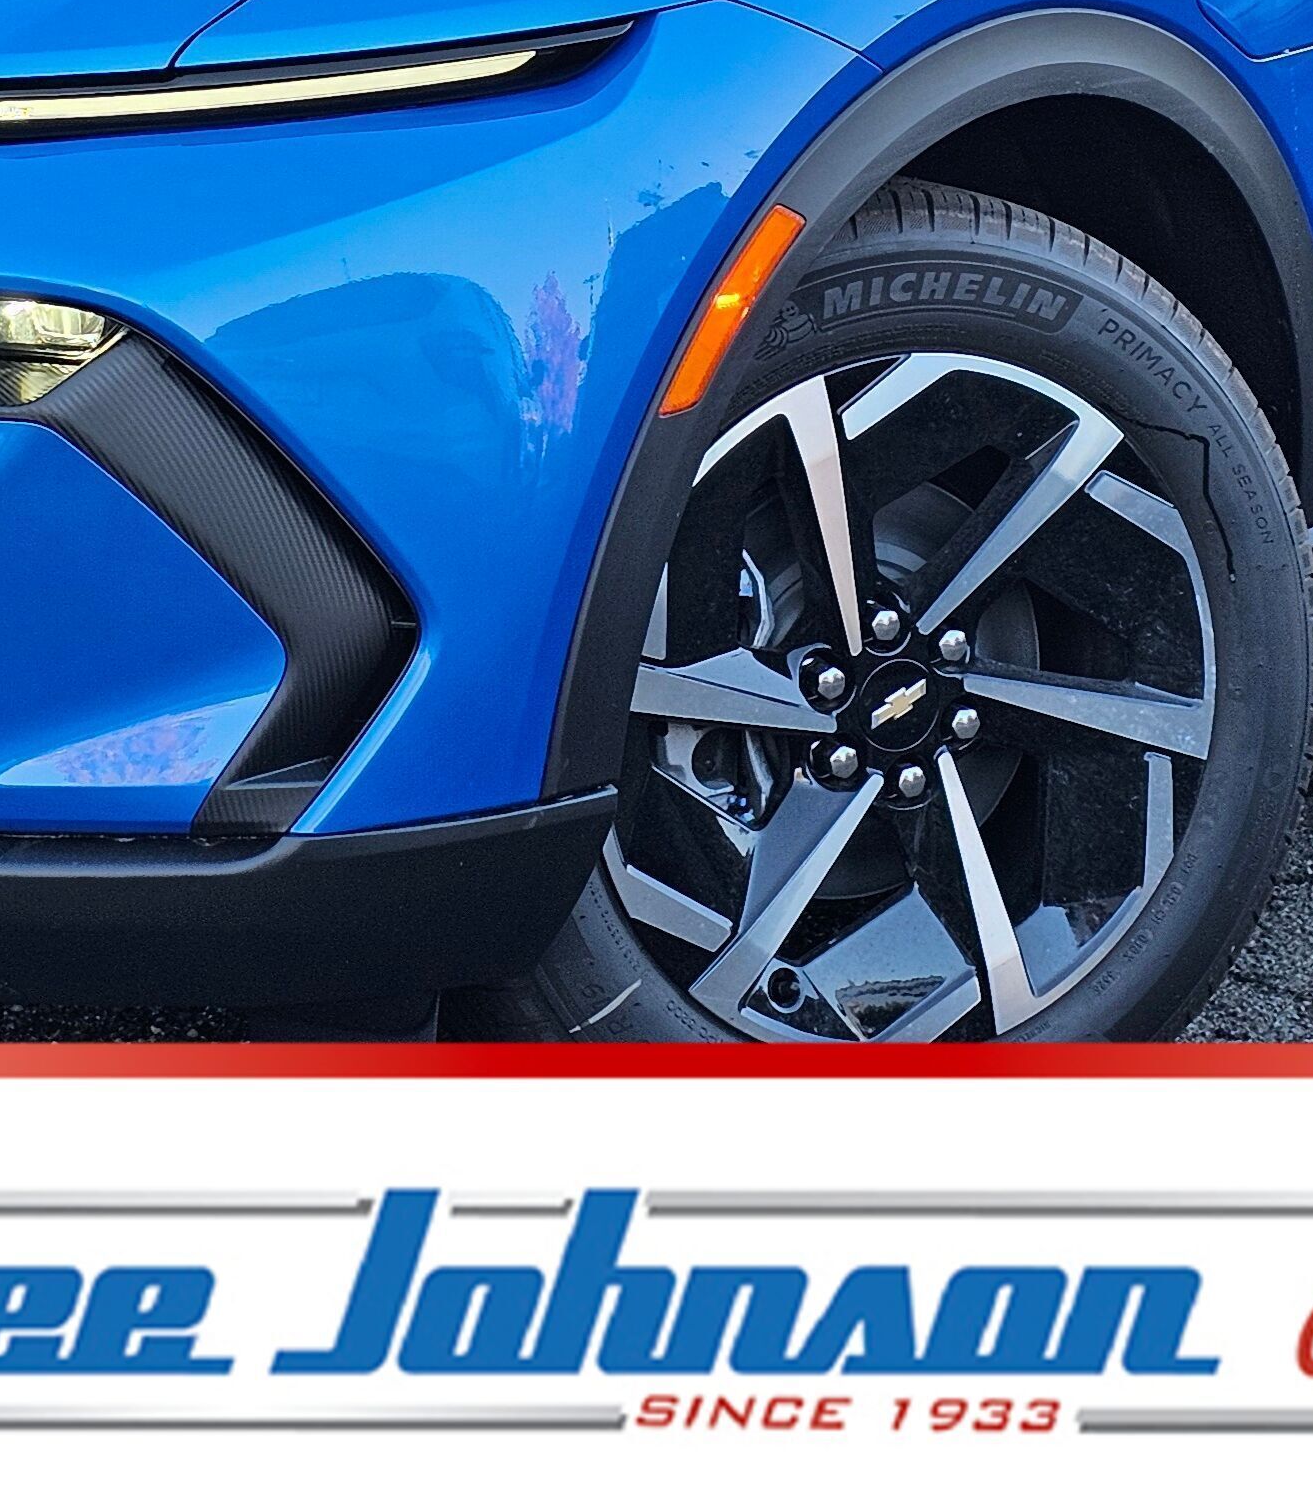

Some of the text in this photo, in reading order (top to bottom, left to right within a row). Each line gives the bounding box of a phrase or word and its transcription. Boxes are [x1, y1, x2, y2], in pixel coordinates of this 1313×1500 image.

[822, 271, 1069, 321] MICHELIN
[1097, 317, 1275, 546] PRIMACY ALL SEASON
